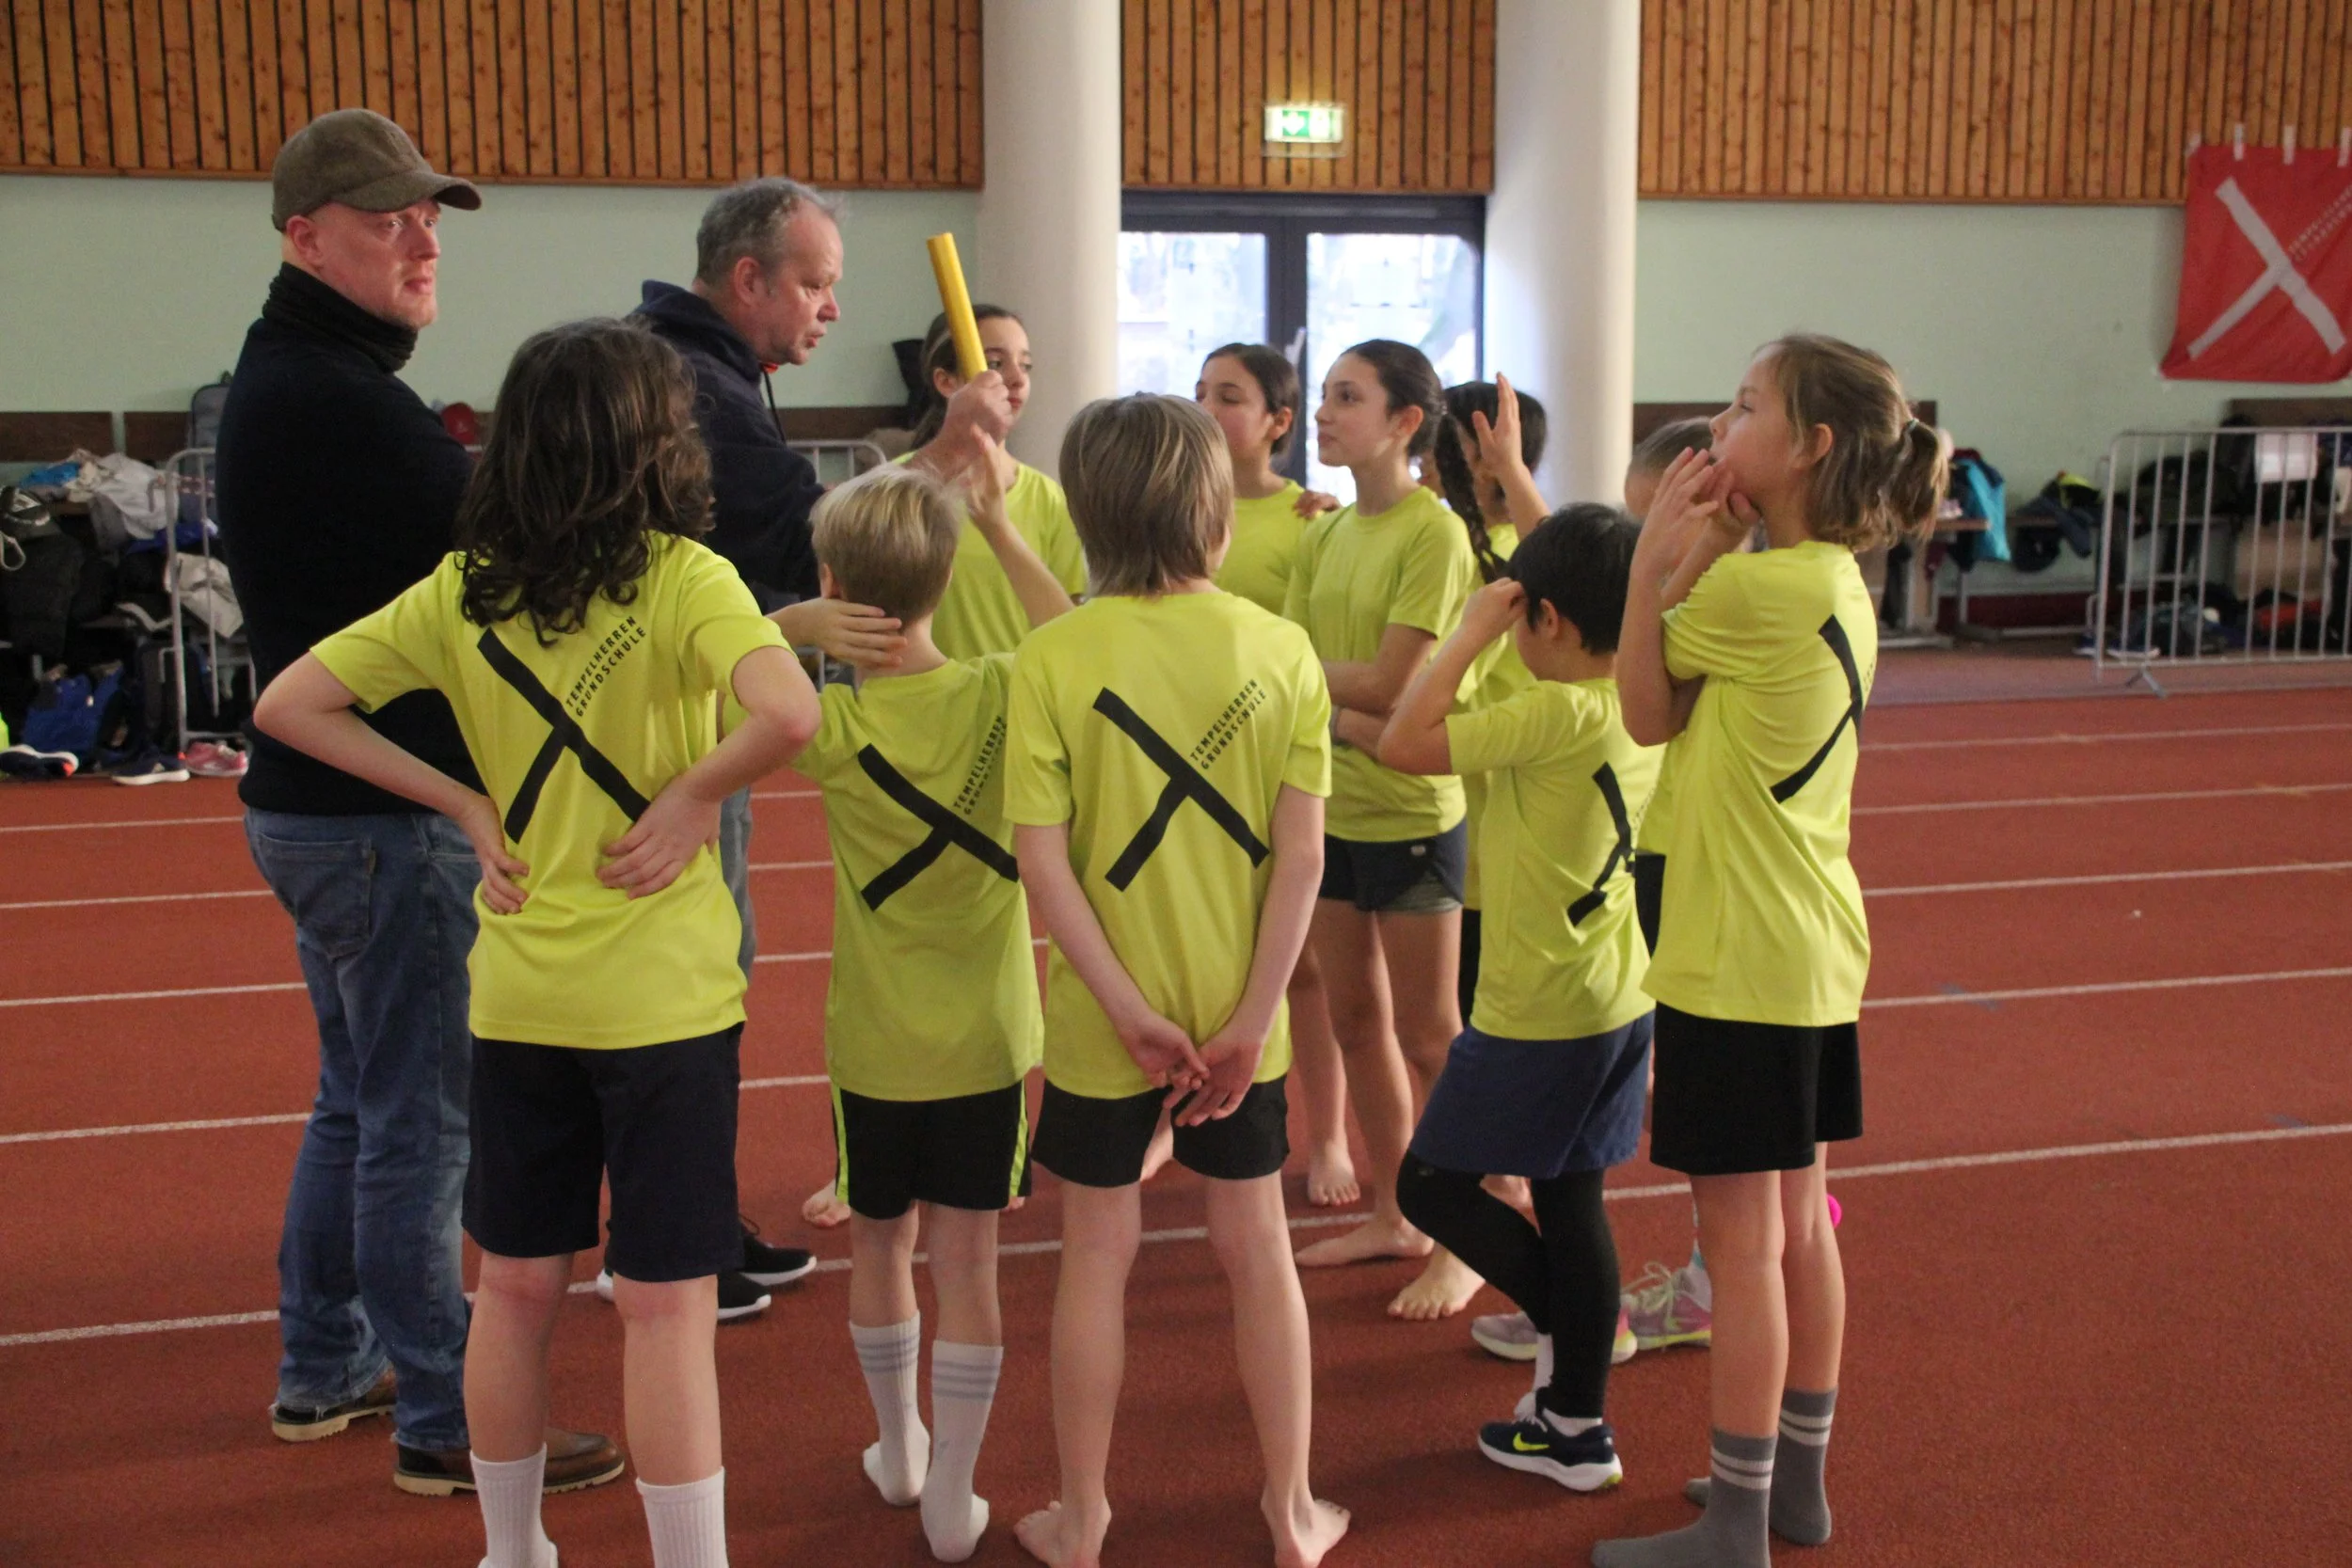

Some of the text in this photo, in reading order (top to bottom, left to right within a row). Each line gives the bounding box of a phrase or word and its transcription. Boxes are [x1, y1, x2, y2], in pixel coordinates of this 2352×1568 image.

[565, 616, 636, 707] TEMPELHERREN
[576, 627, 646, 717] GRUNDSCHULE
[1190, 679, 1257, 761] TEMPELHERREN
[1200, 689, 1266, 769] GRUNDSCHULE
